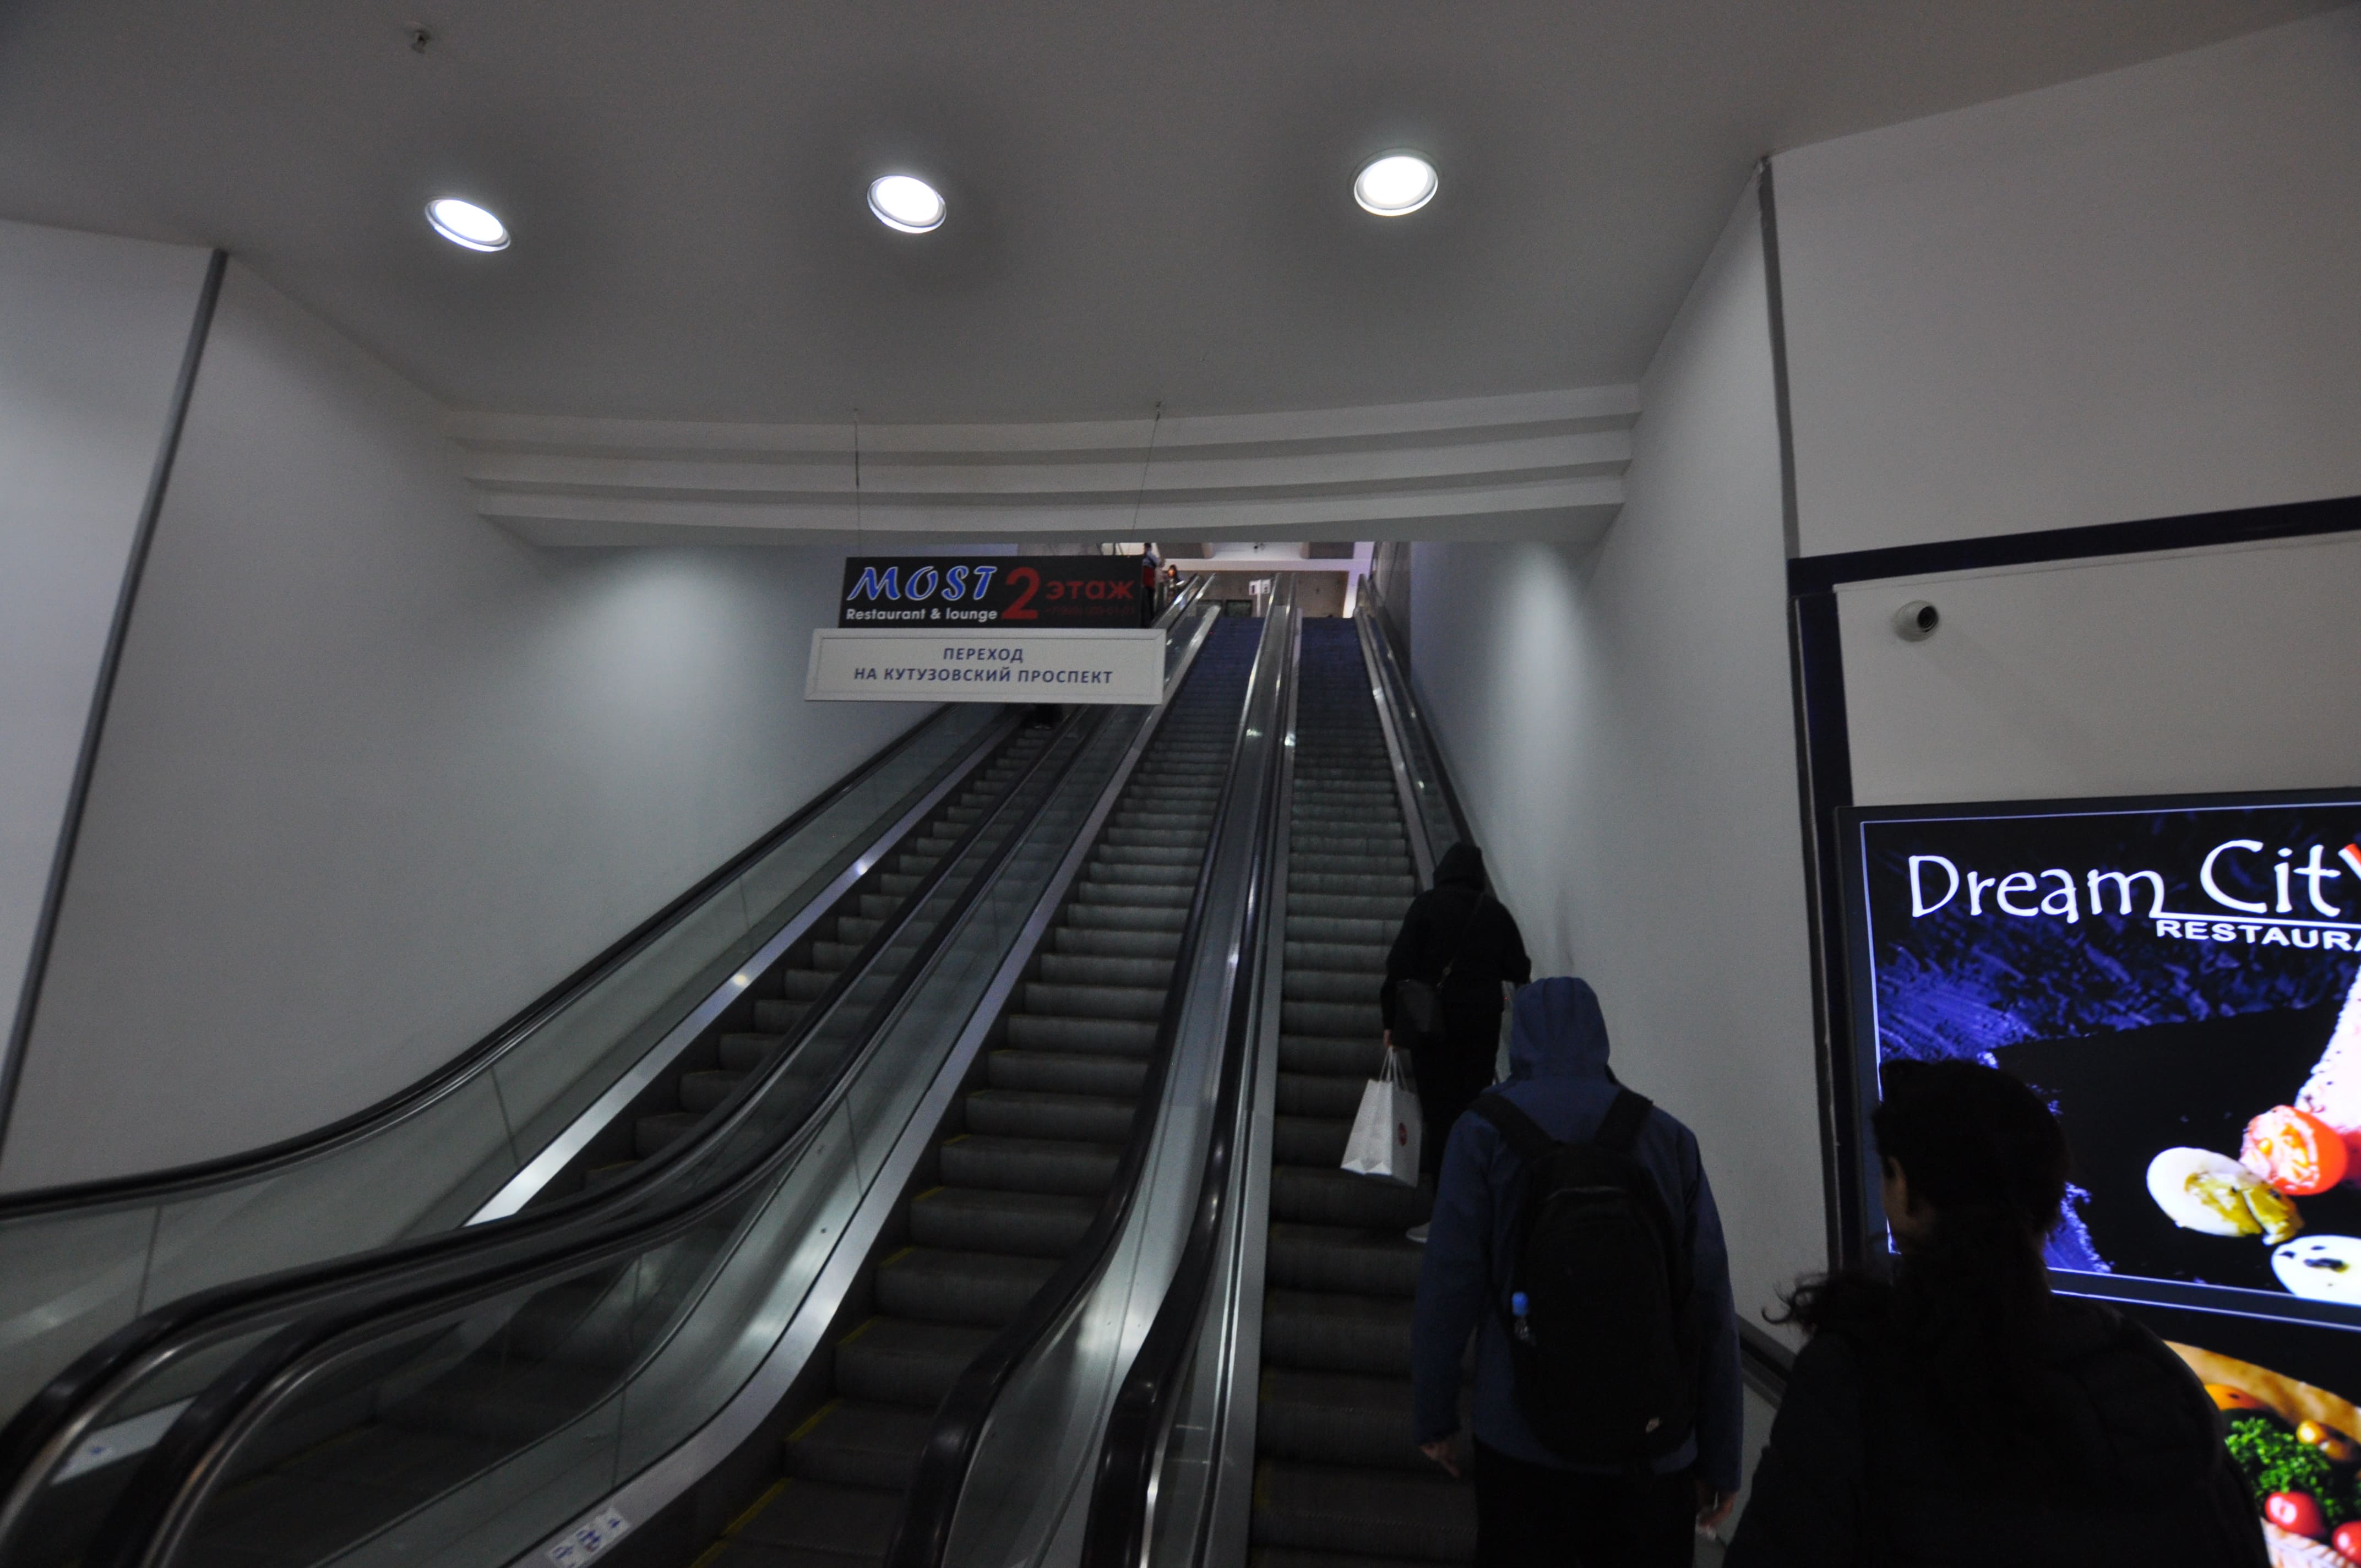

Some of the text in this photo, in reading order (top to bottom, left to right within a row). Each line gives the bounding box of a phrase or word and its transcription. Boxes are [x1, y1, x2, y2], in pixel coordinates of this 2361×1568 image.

[846, 565, 998, 601] MOST
[1000, 567, 1135, 620] 2 этаж
[846, 607, 998, 623] Restaurant & lounge
[943, 647, 1024, 663] ПЕРЕХОД
[854, 666, 1113, 684] НА КУТУЗОВСКИЙ ПРОСПЕКТ
[1907, 854, 2166, 923] Dream
